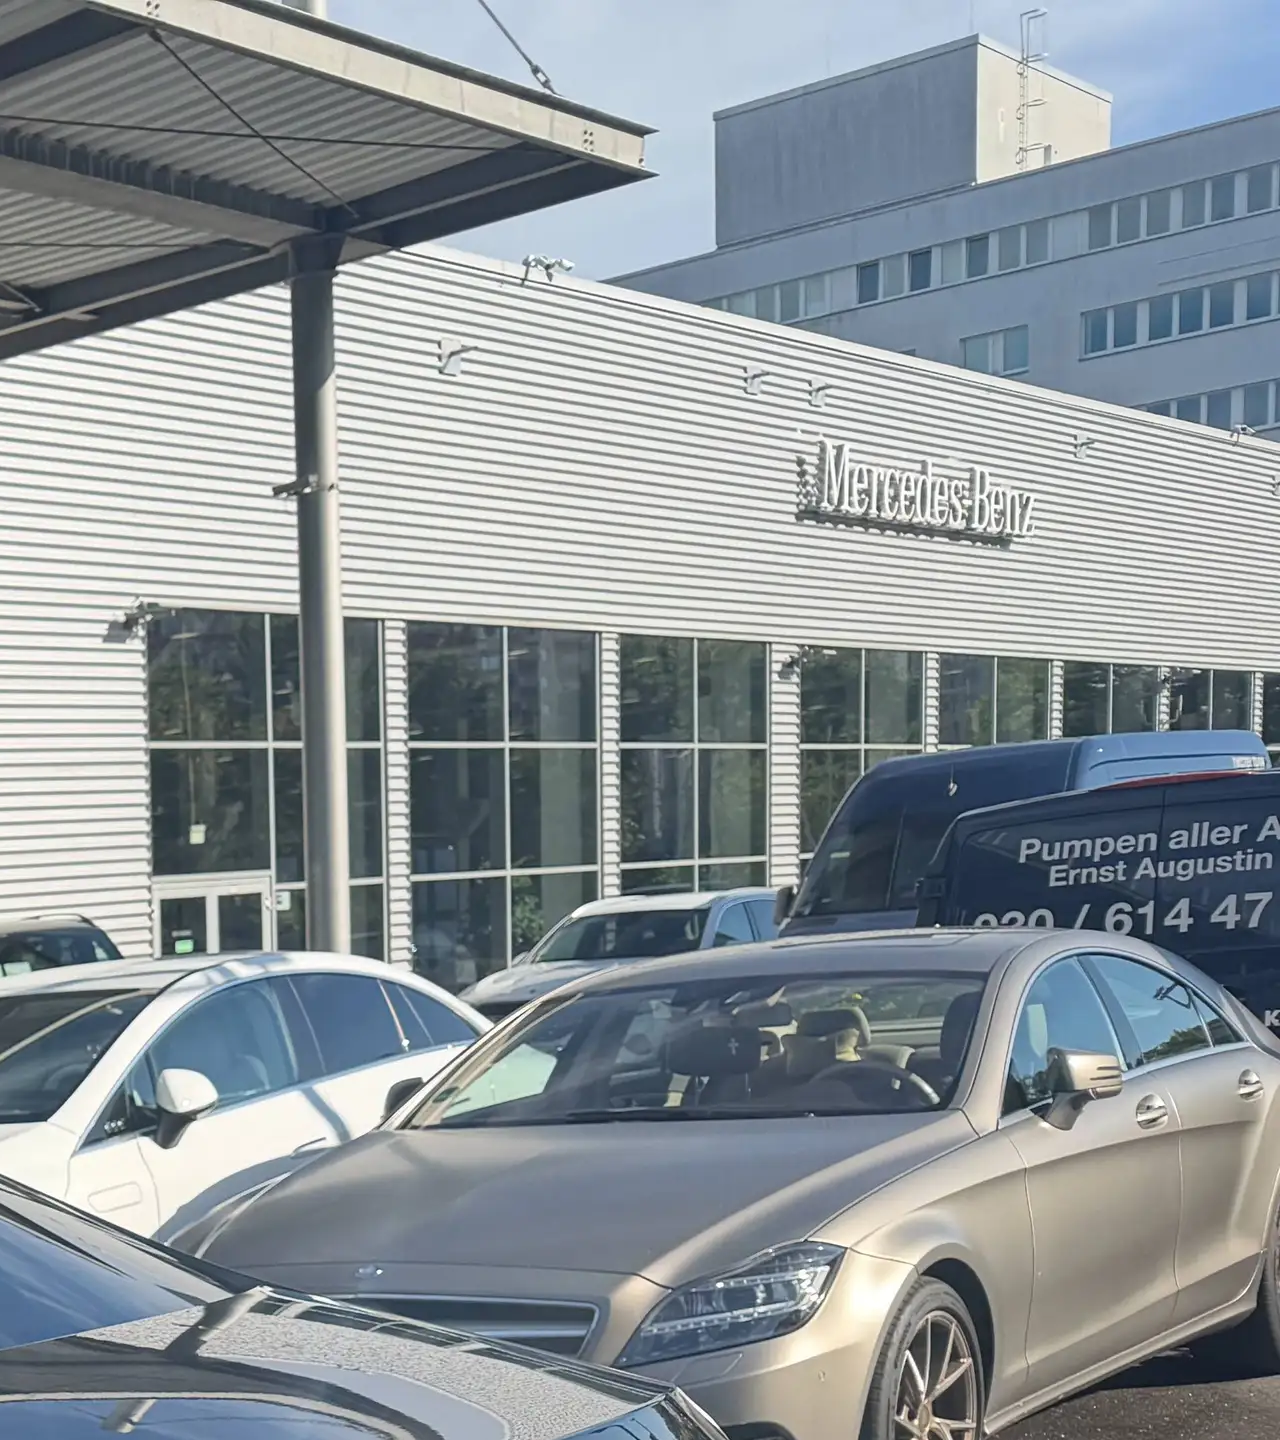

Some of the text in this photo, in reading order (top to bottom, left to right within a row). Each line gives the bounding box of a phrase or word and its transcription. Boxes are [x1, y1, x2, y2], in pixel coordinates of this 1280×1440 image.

[817, 439, 1037, 535] Mercedes-Benz
[1018, 831, 1158, 864] Pumpen
[1168, 822, 1249, 850] aller
[1048, 849, 1274, 888] Ernst Augustin
[1104, 898, 1194, 935] 614
[1210, 891, 1274, 930] 47
